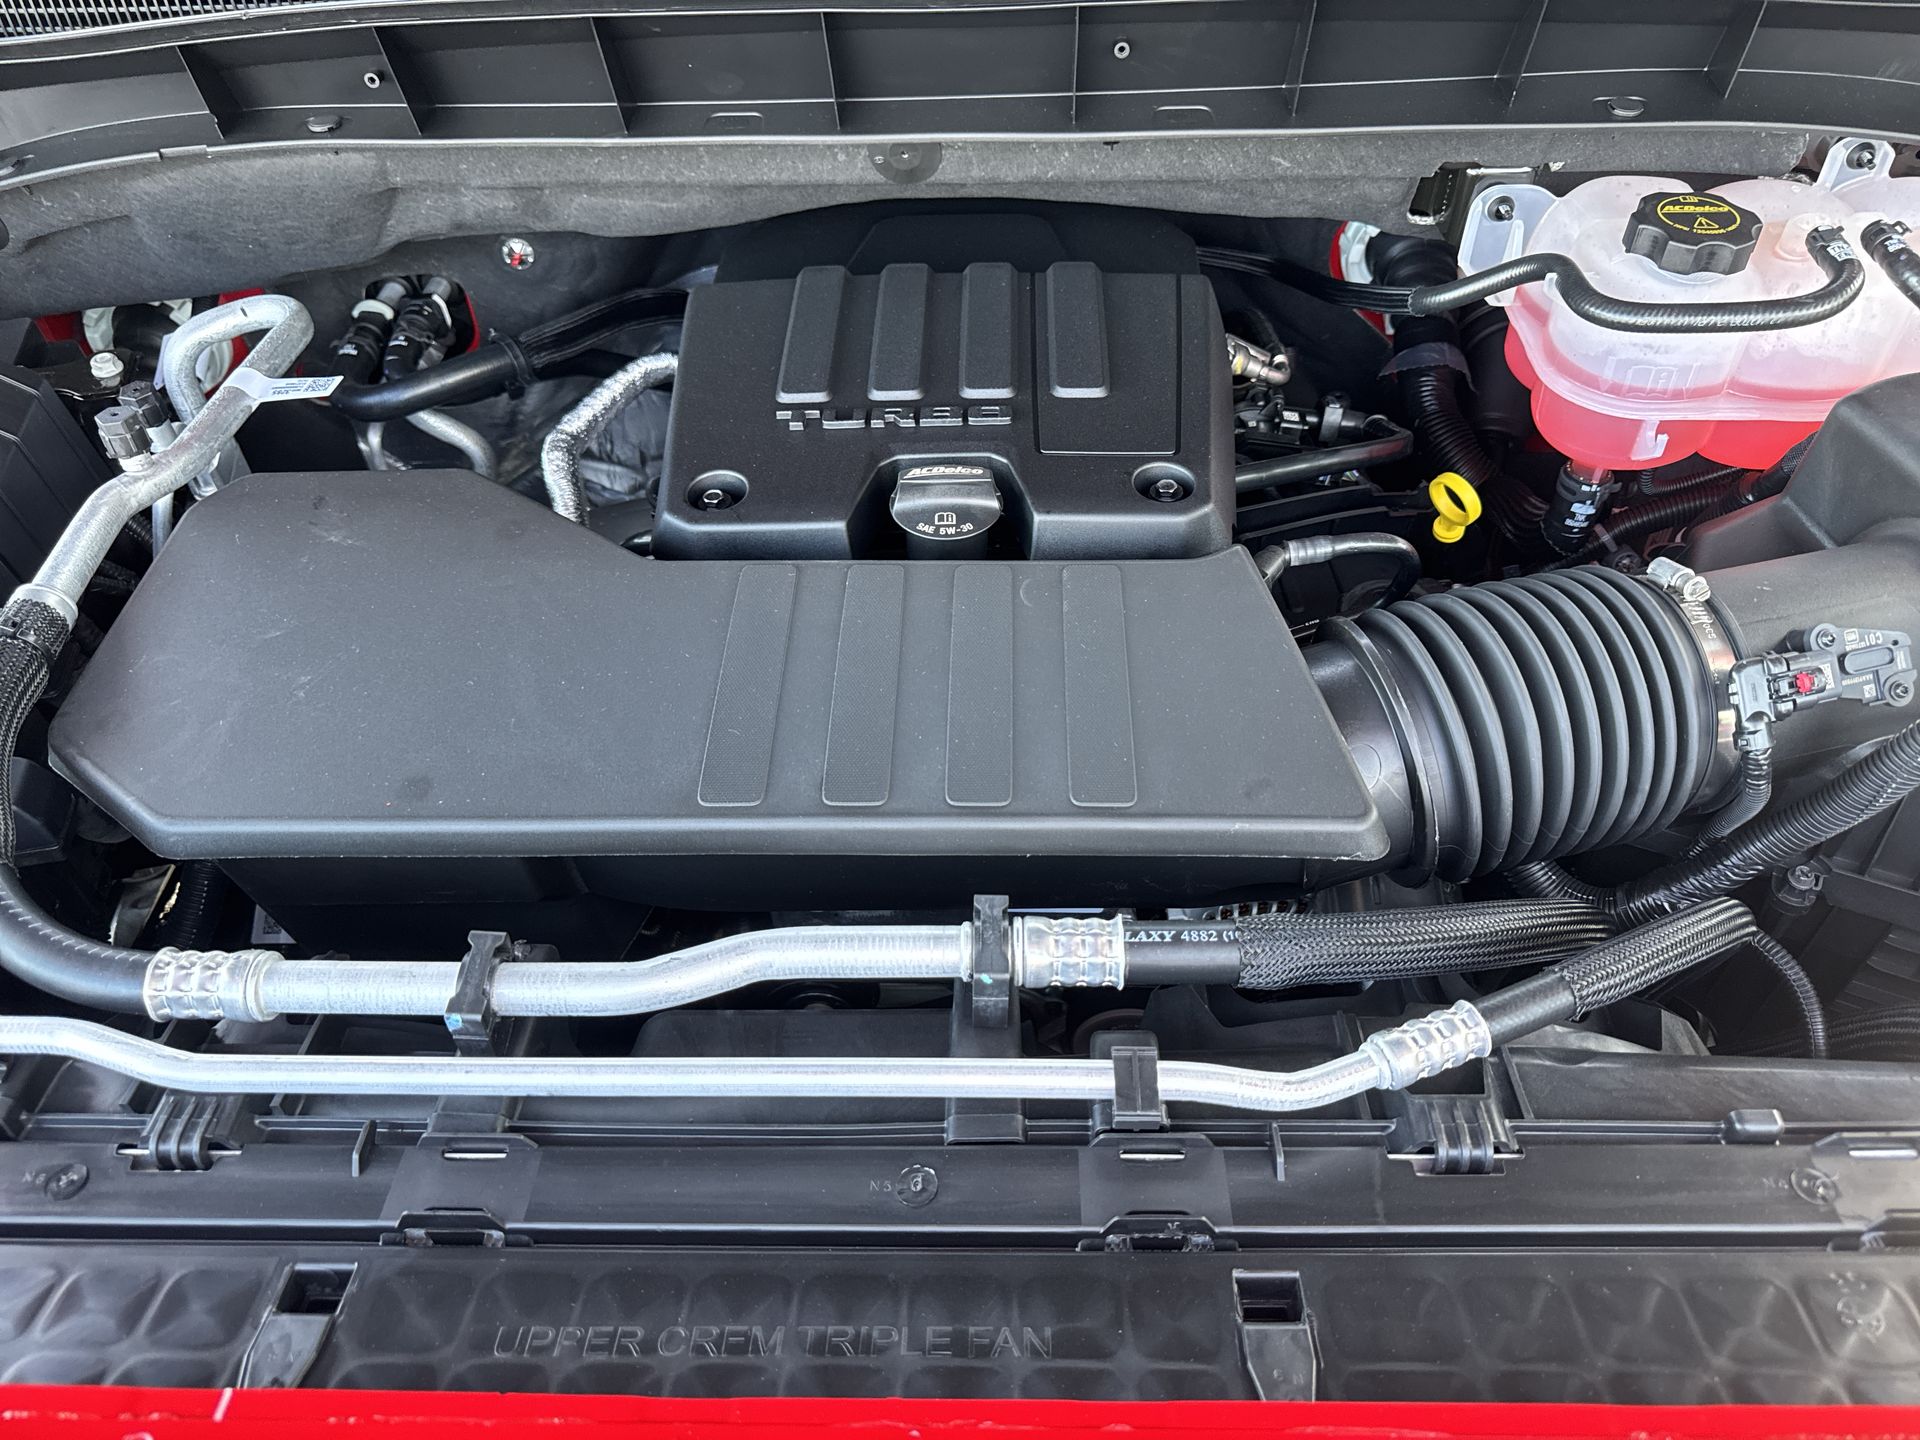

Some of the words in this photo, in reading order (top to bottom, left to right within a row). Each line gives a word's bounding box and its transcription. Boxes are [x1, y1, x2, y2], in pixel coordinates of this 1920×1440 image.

[1661, 205, 1730, 213] ACDelco
[776, 407, 1012, 430] TURBO
[904, 466, 984, 479] ACDelco
[916, 522, 936, 534] SAE
[939, 522, 974, 535] 5W-30
[1124, 930, 1176, 942] LAXY
[1180, 930, 1218, 942] 4882
[493, 1325, 645, 1358] UPPER
[798, 1325, 953, 1358] TRIPLE
[968, 1325, 1053, 1359] FAN
